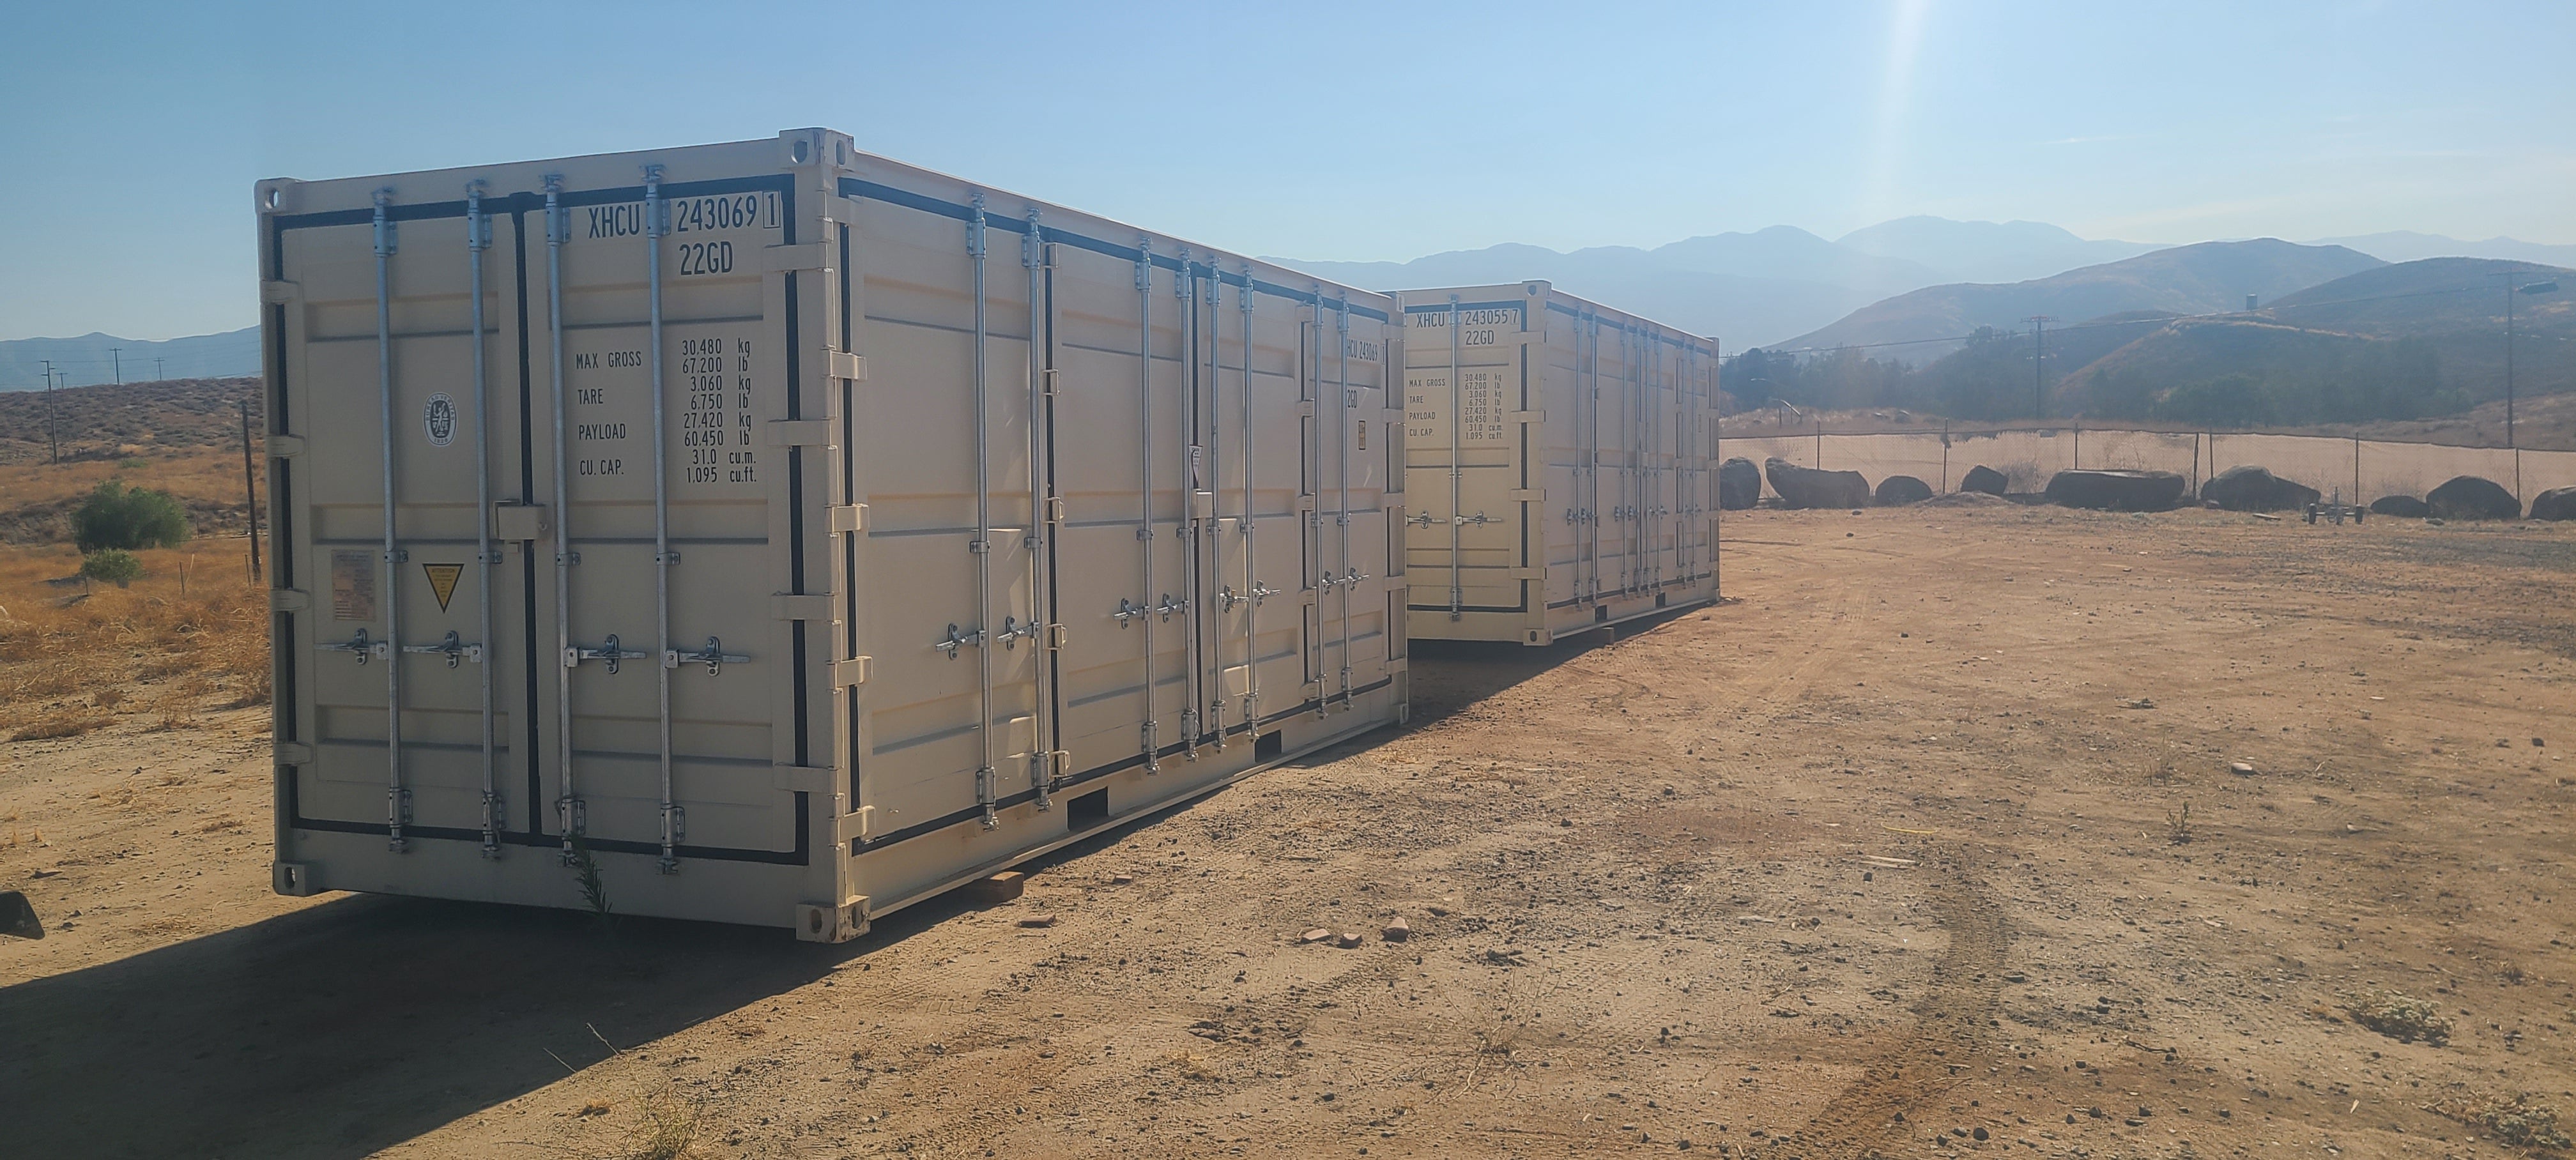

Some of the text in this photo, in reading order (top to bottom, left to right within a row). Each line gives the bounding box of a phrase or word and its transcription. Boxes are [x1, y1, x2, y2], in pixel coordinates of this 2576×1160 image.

[588, 193, 776, 239] XHCU 243069 1
[680, 241, 733, 276] 22GD
[1416, 309, 1518, 328] XHCU 243055 7
[1466, 330, 1494, 345] 22GD
[738, 337, 750, 358] kg
[1347, 339, 1357, 358] HCU
[1360, 341, 1377, 362] 243069
[576, 351, 642, 369] MAX GROSS
[738, 356, 748, 372] lb
[739, 374, 751, 395] kg
[1409, 378, 1446, 388] MAX GROSS
[1494, 373, 1501, 383] kg
[578, 388, 604, 406] TARE
[739, 393, 748, 409] lb
[1409, 395, 1424, 404] TARE
[1494, 390, 1501, 399] kg
[1409, 411, 1436, 420] PAYLOAD
[1494, 407, 1502, 416] kg
[739, 411, 751, 432] kg
[579, 424, 626, 440] PAYLOAD
[740, 430, 749, 445] lb
[1420, 428, 1434, 436] CAP.
[693, 448, 756, 465] 31.0 cu.m.
[580, 459, 624, 475] CU. CAP.
[730, 466, 756, 482] cu.ft.
